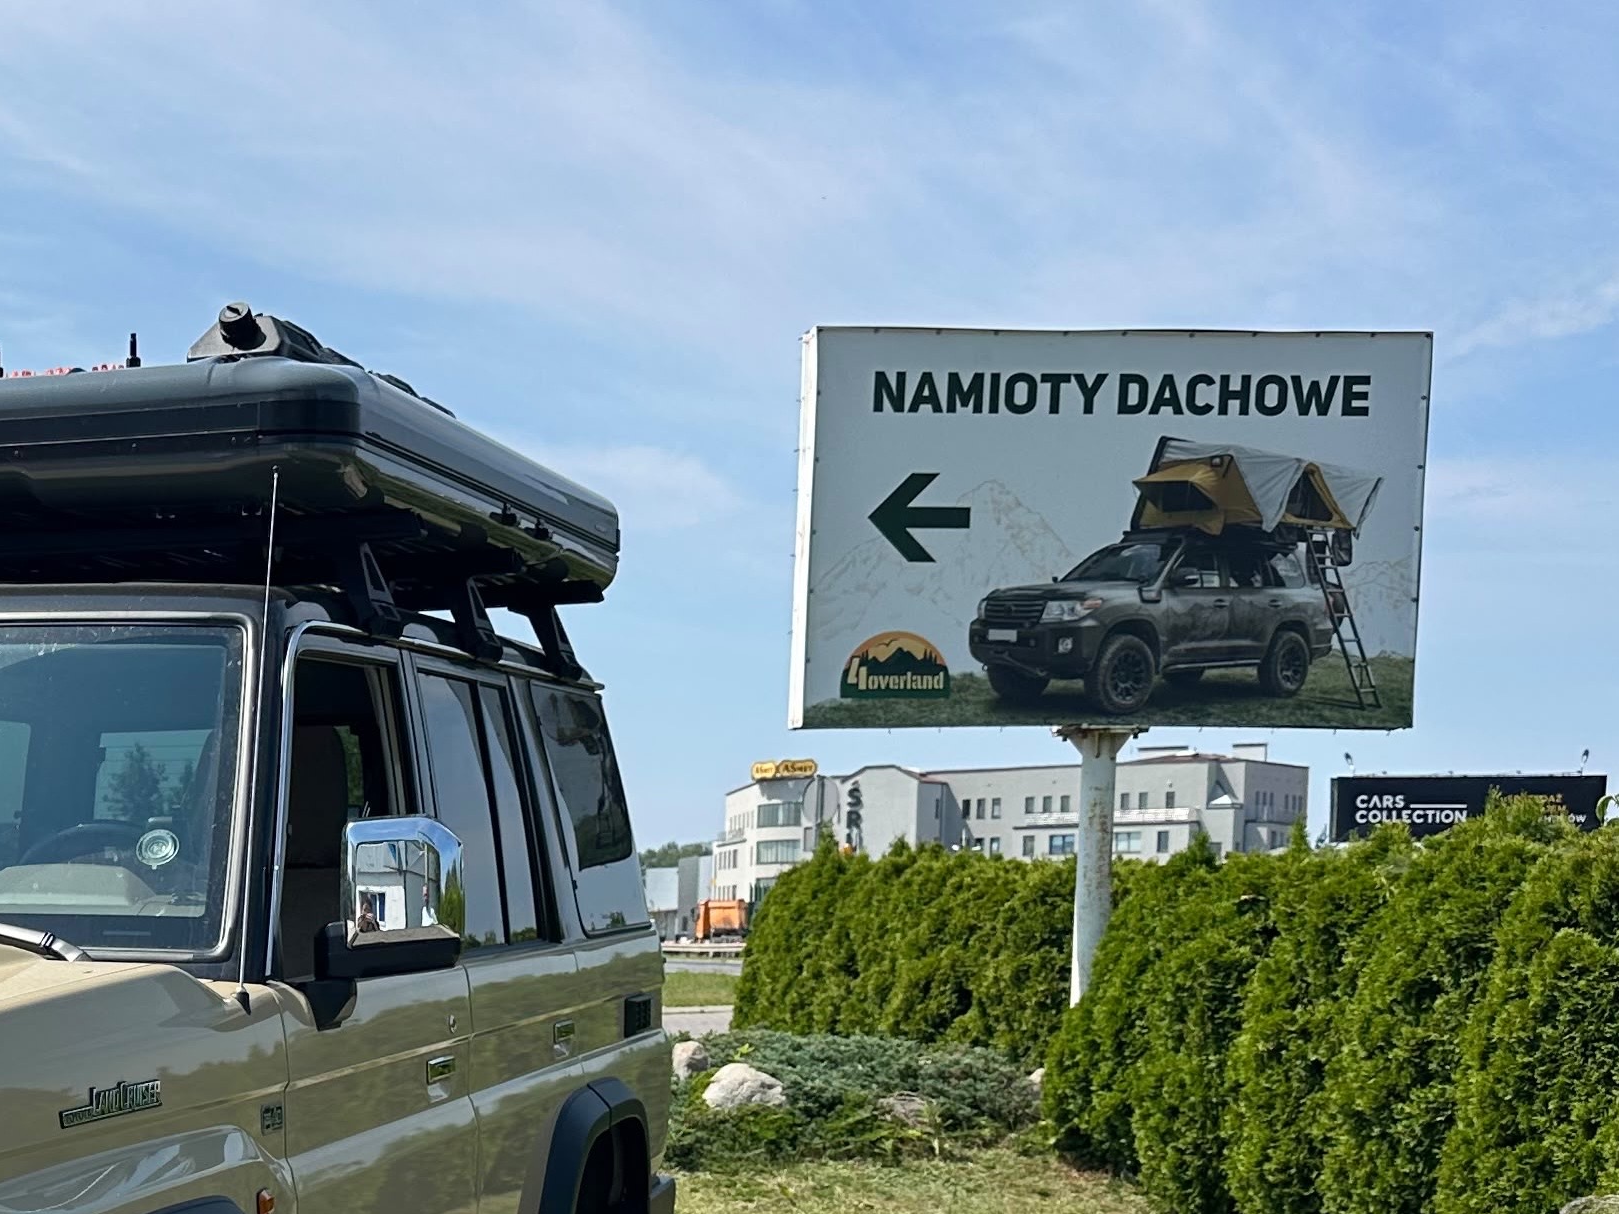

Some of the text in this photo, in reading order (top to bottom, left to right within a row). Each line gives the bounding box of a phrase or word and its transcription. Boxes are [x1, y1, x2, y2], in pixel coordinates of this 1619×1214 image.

[873, 371, 1371, 416] NAMIOTY DACHOWE
[1356, 795, 1404, 808] CARS
[1355, 810, 1467, 823] COLLECTION
